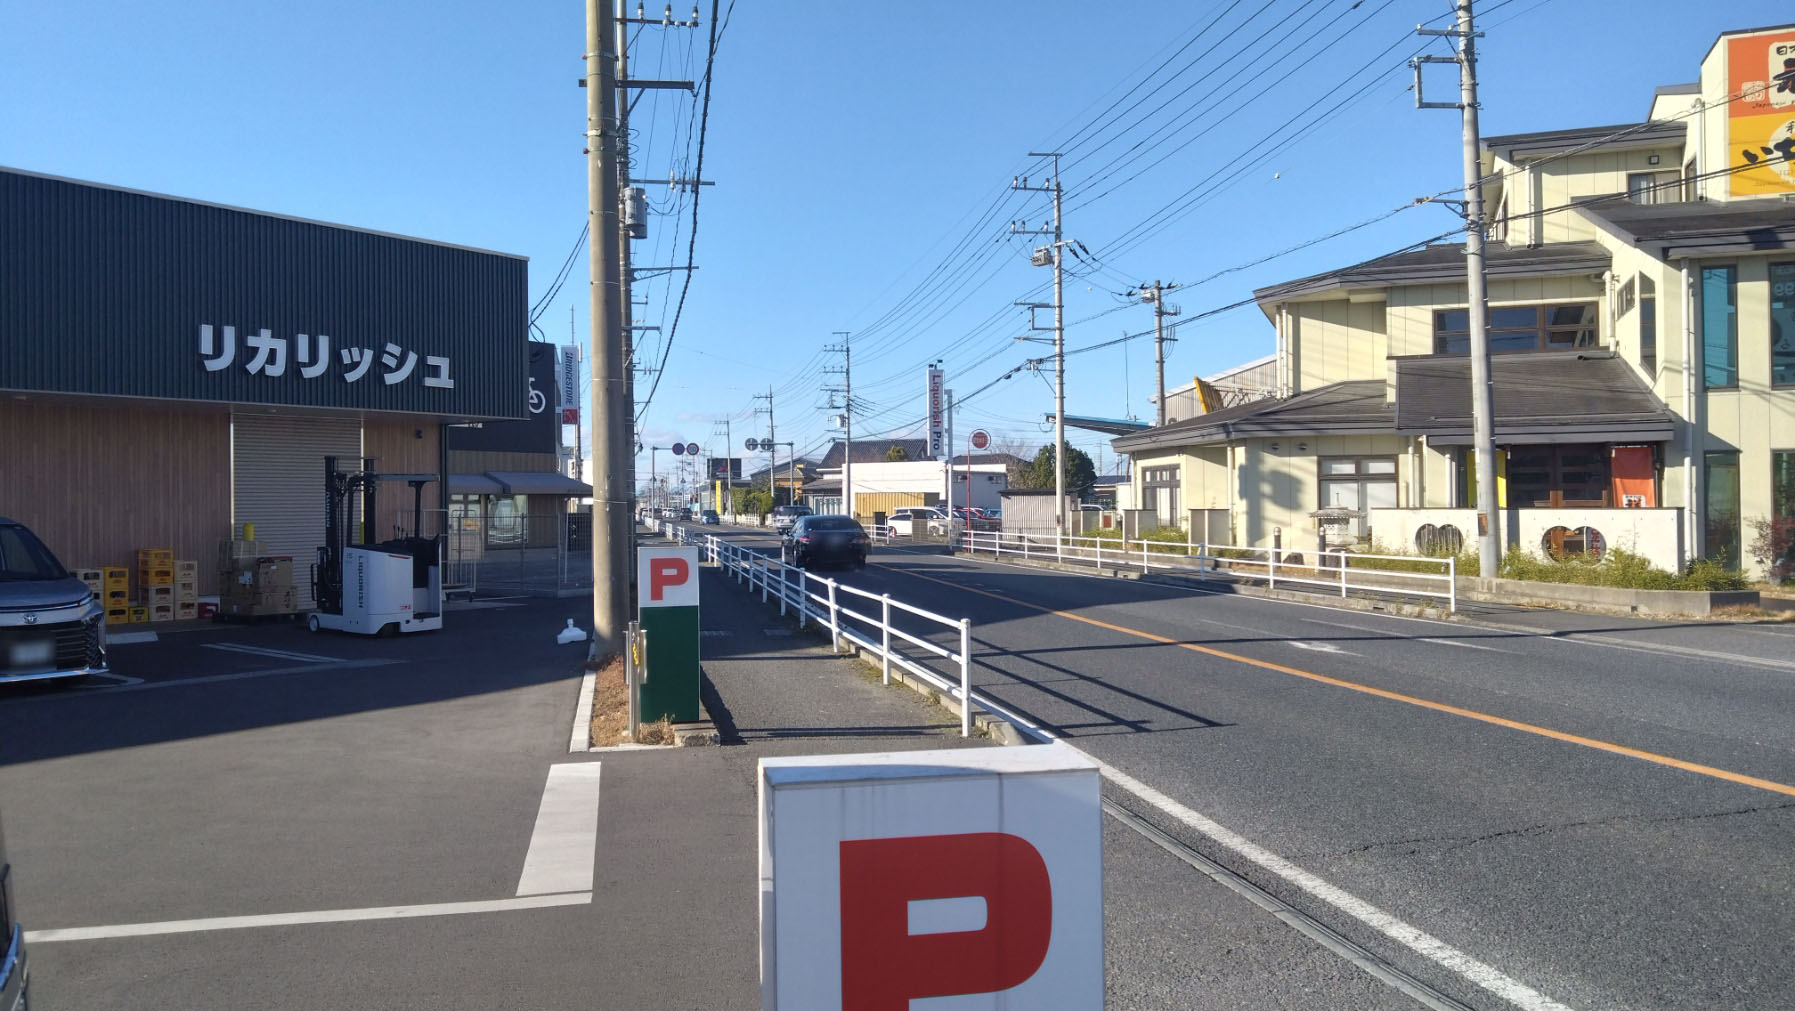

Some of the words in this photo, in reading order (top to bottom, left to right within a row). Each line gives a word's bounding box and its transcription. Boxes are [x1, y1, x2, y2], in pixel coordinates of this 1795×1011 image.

[200, 323, 455, 389] リカリッシュ
[565, 352, 574, 405] BRIDGESTONE
[930, 375, 941, 427] Liquorish
[933, 432, 941, 450] Pro
[650, 557, 690, 601] P
[839, 831, 1053, 1011] P
